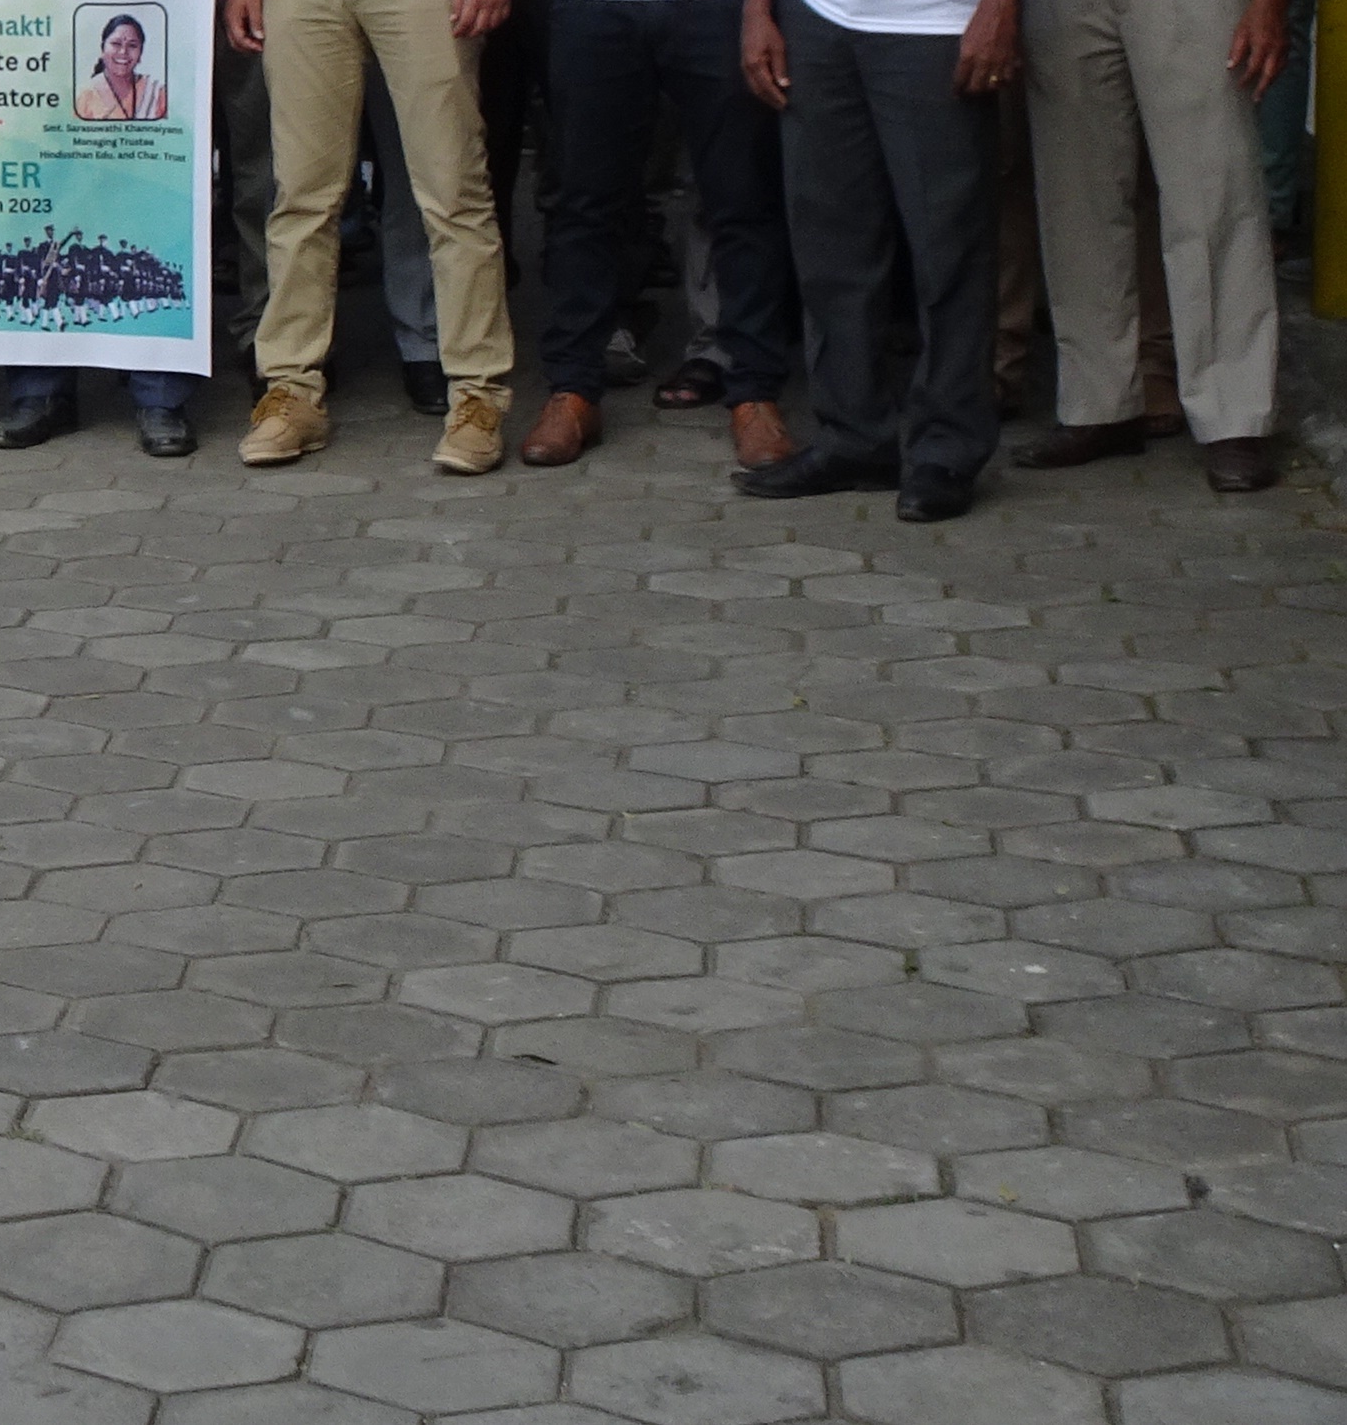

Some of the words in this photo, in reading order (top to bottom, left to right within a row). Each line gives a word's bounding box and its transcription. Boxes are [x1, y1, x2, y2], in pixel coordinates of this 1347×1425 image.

[26, 51, 51, 73] of
[72, 137, 117, 148] Managing
[119, 137, 154, 147] Trustee
[39, 151, 93, 160] Hindusthan
[117, 151, 135, 160] and
[164, 152, 186, 162] Trust
[8, 198, 53, 213] 2023
